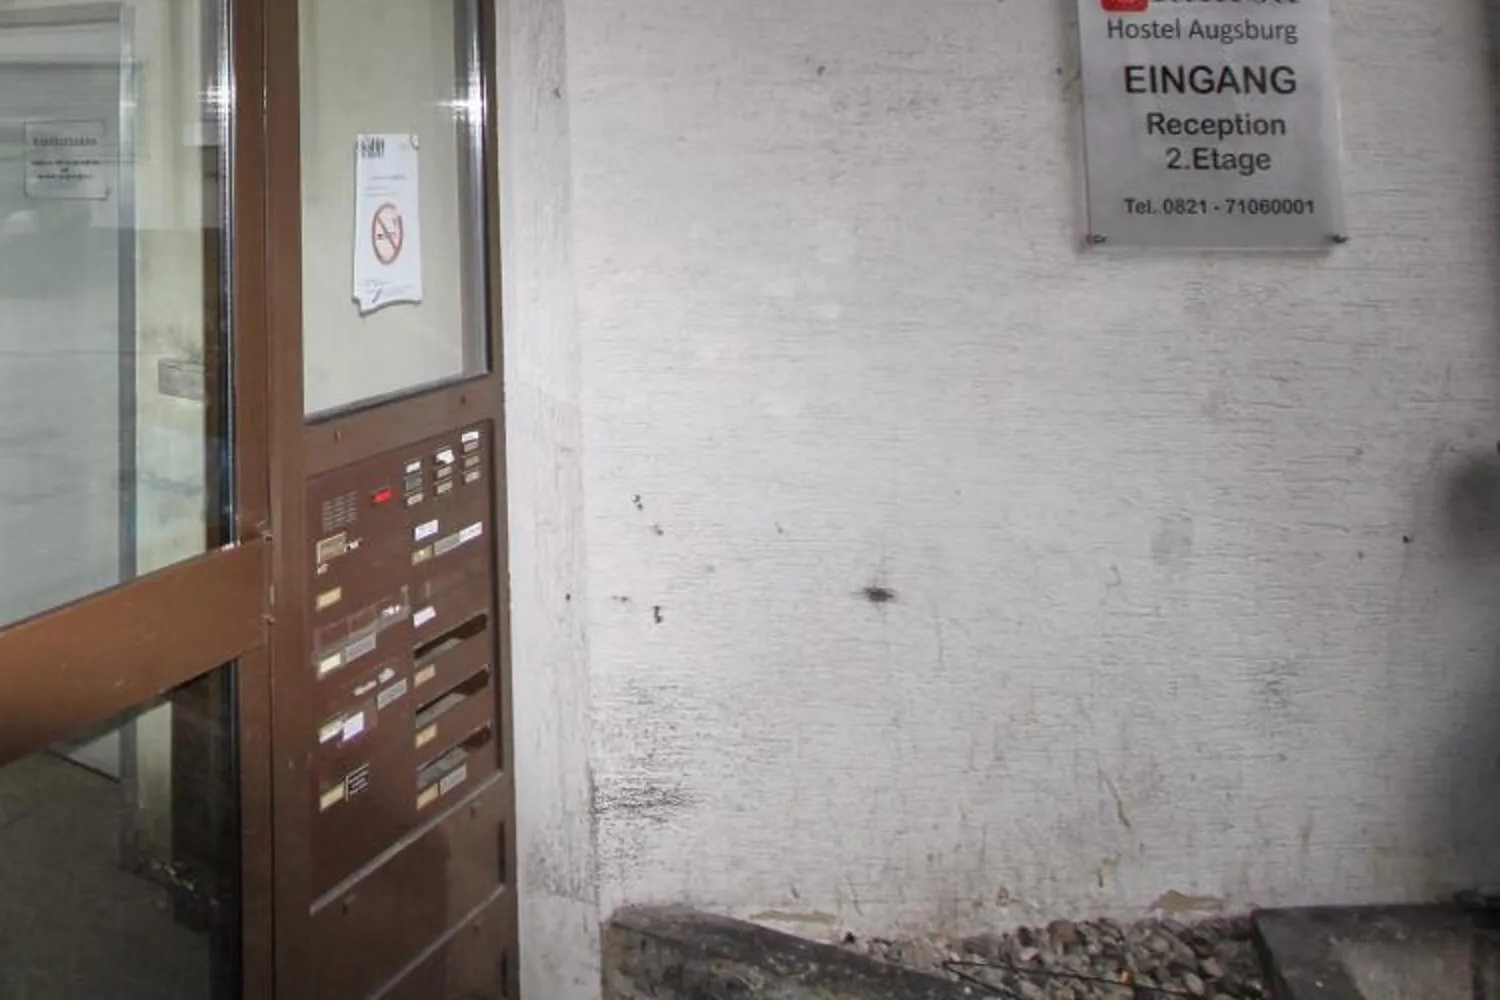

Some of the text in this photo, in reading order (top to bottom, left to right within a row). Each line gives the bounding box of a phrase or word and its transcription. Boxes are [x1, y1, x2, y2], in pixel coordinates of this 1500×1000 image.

[1107, 18, 1298, 44] Hostel Augsburg
[1124, 65, 1297, 95] EINGANG
[1147, 112, 1286, 140] Reception
[1124, 197, 1158, 215] Tel.
[1162, 198, 1208, 215] 0821
